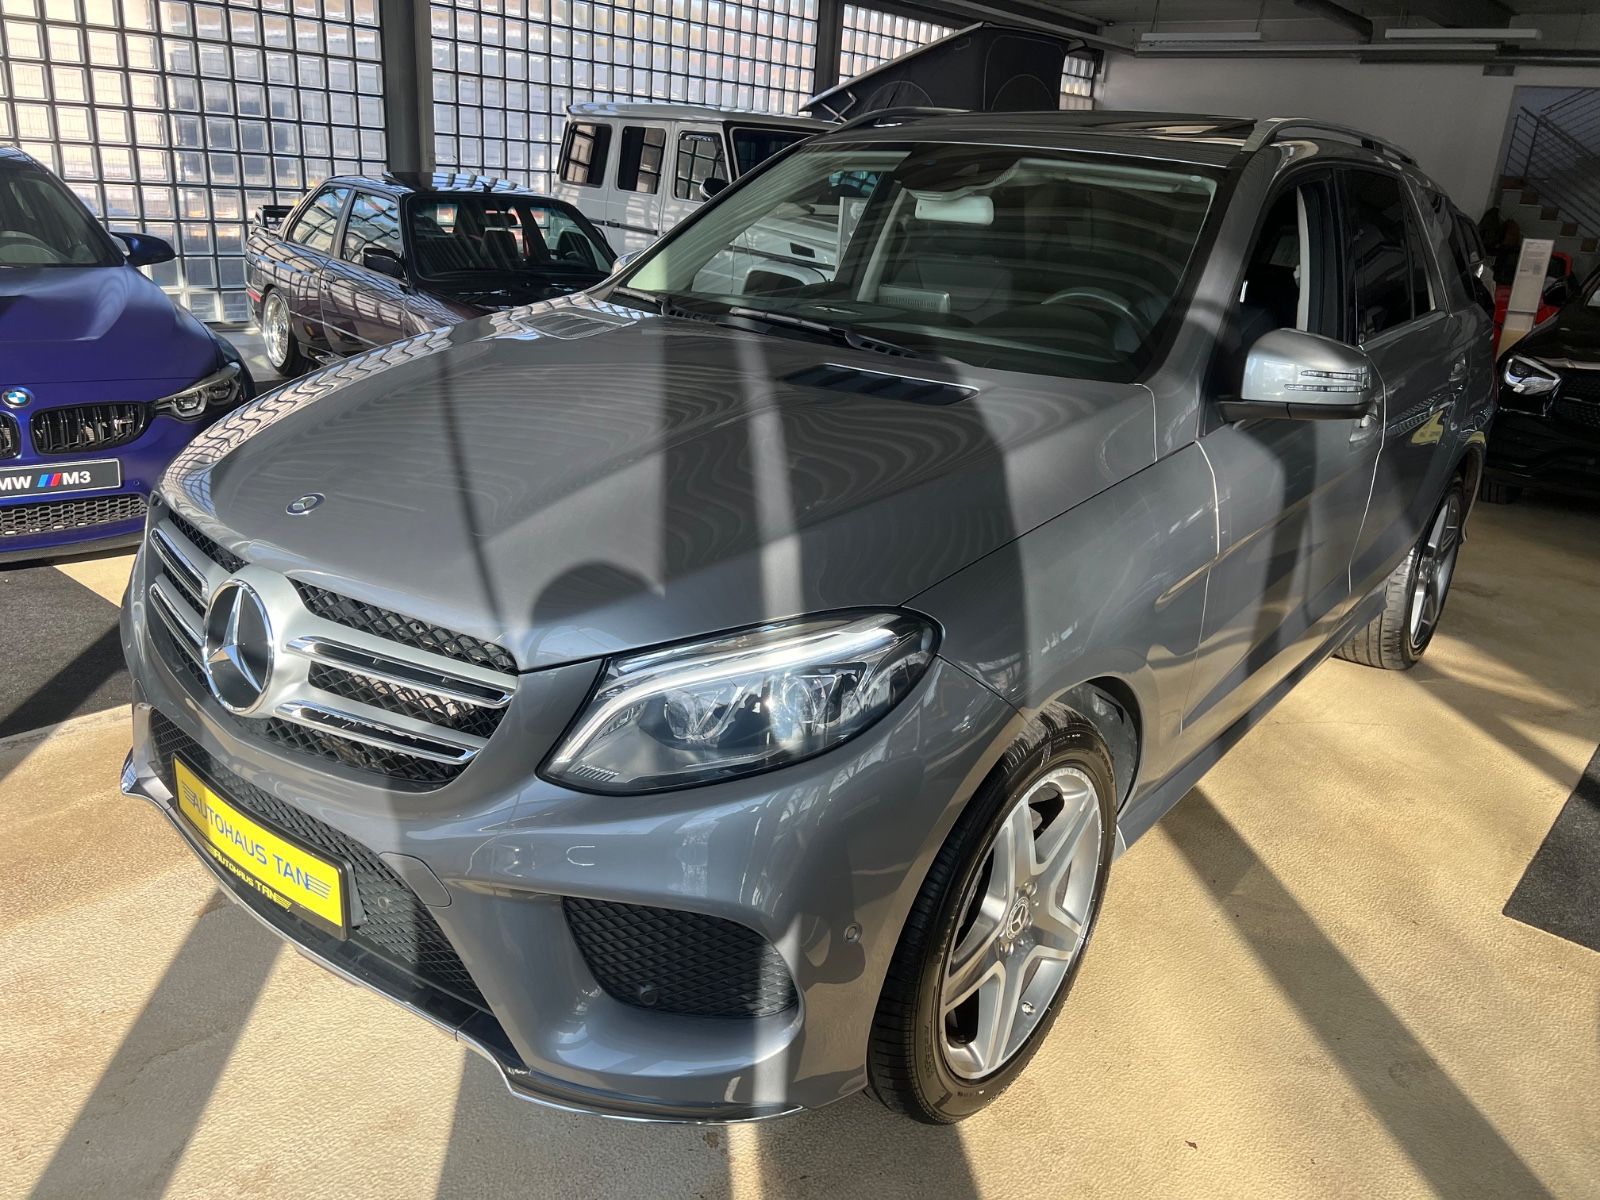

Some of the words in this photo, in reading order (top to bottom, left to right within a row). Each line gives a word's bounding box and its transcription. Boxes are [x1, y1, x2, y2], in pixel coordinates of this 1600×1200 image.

[192, 794, 267, 865] AUTOHAUS
[273, 853, 310, 891] TAN
[213, 849, 255, 888] AUTOHAUS
[255, 881, 277, 901] TAN
